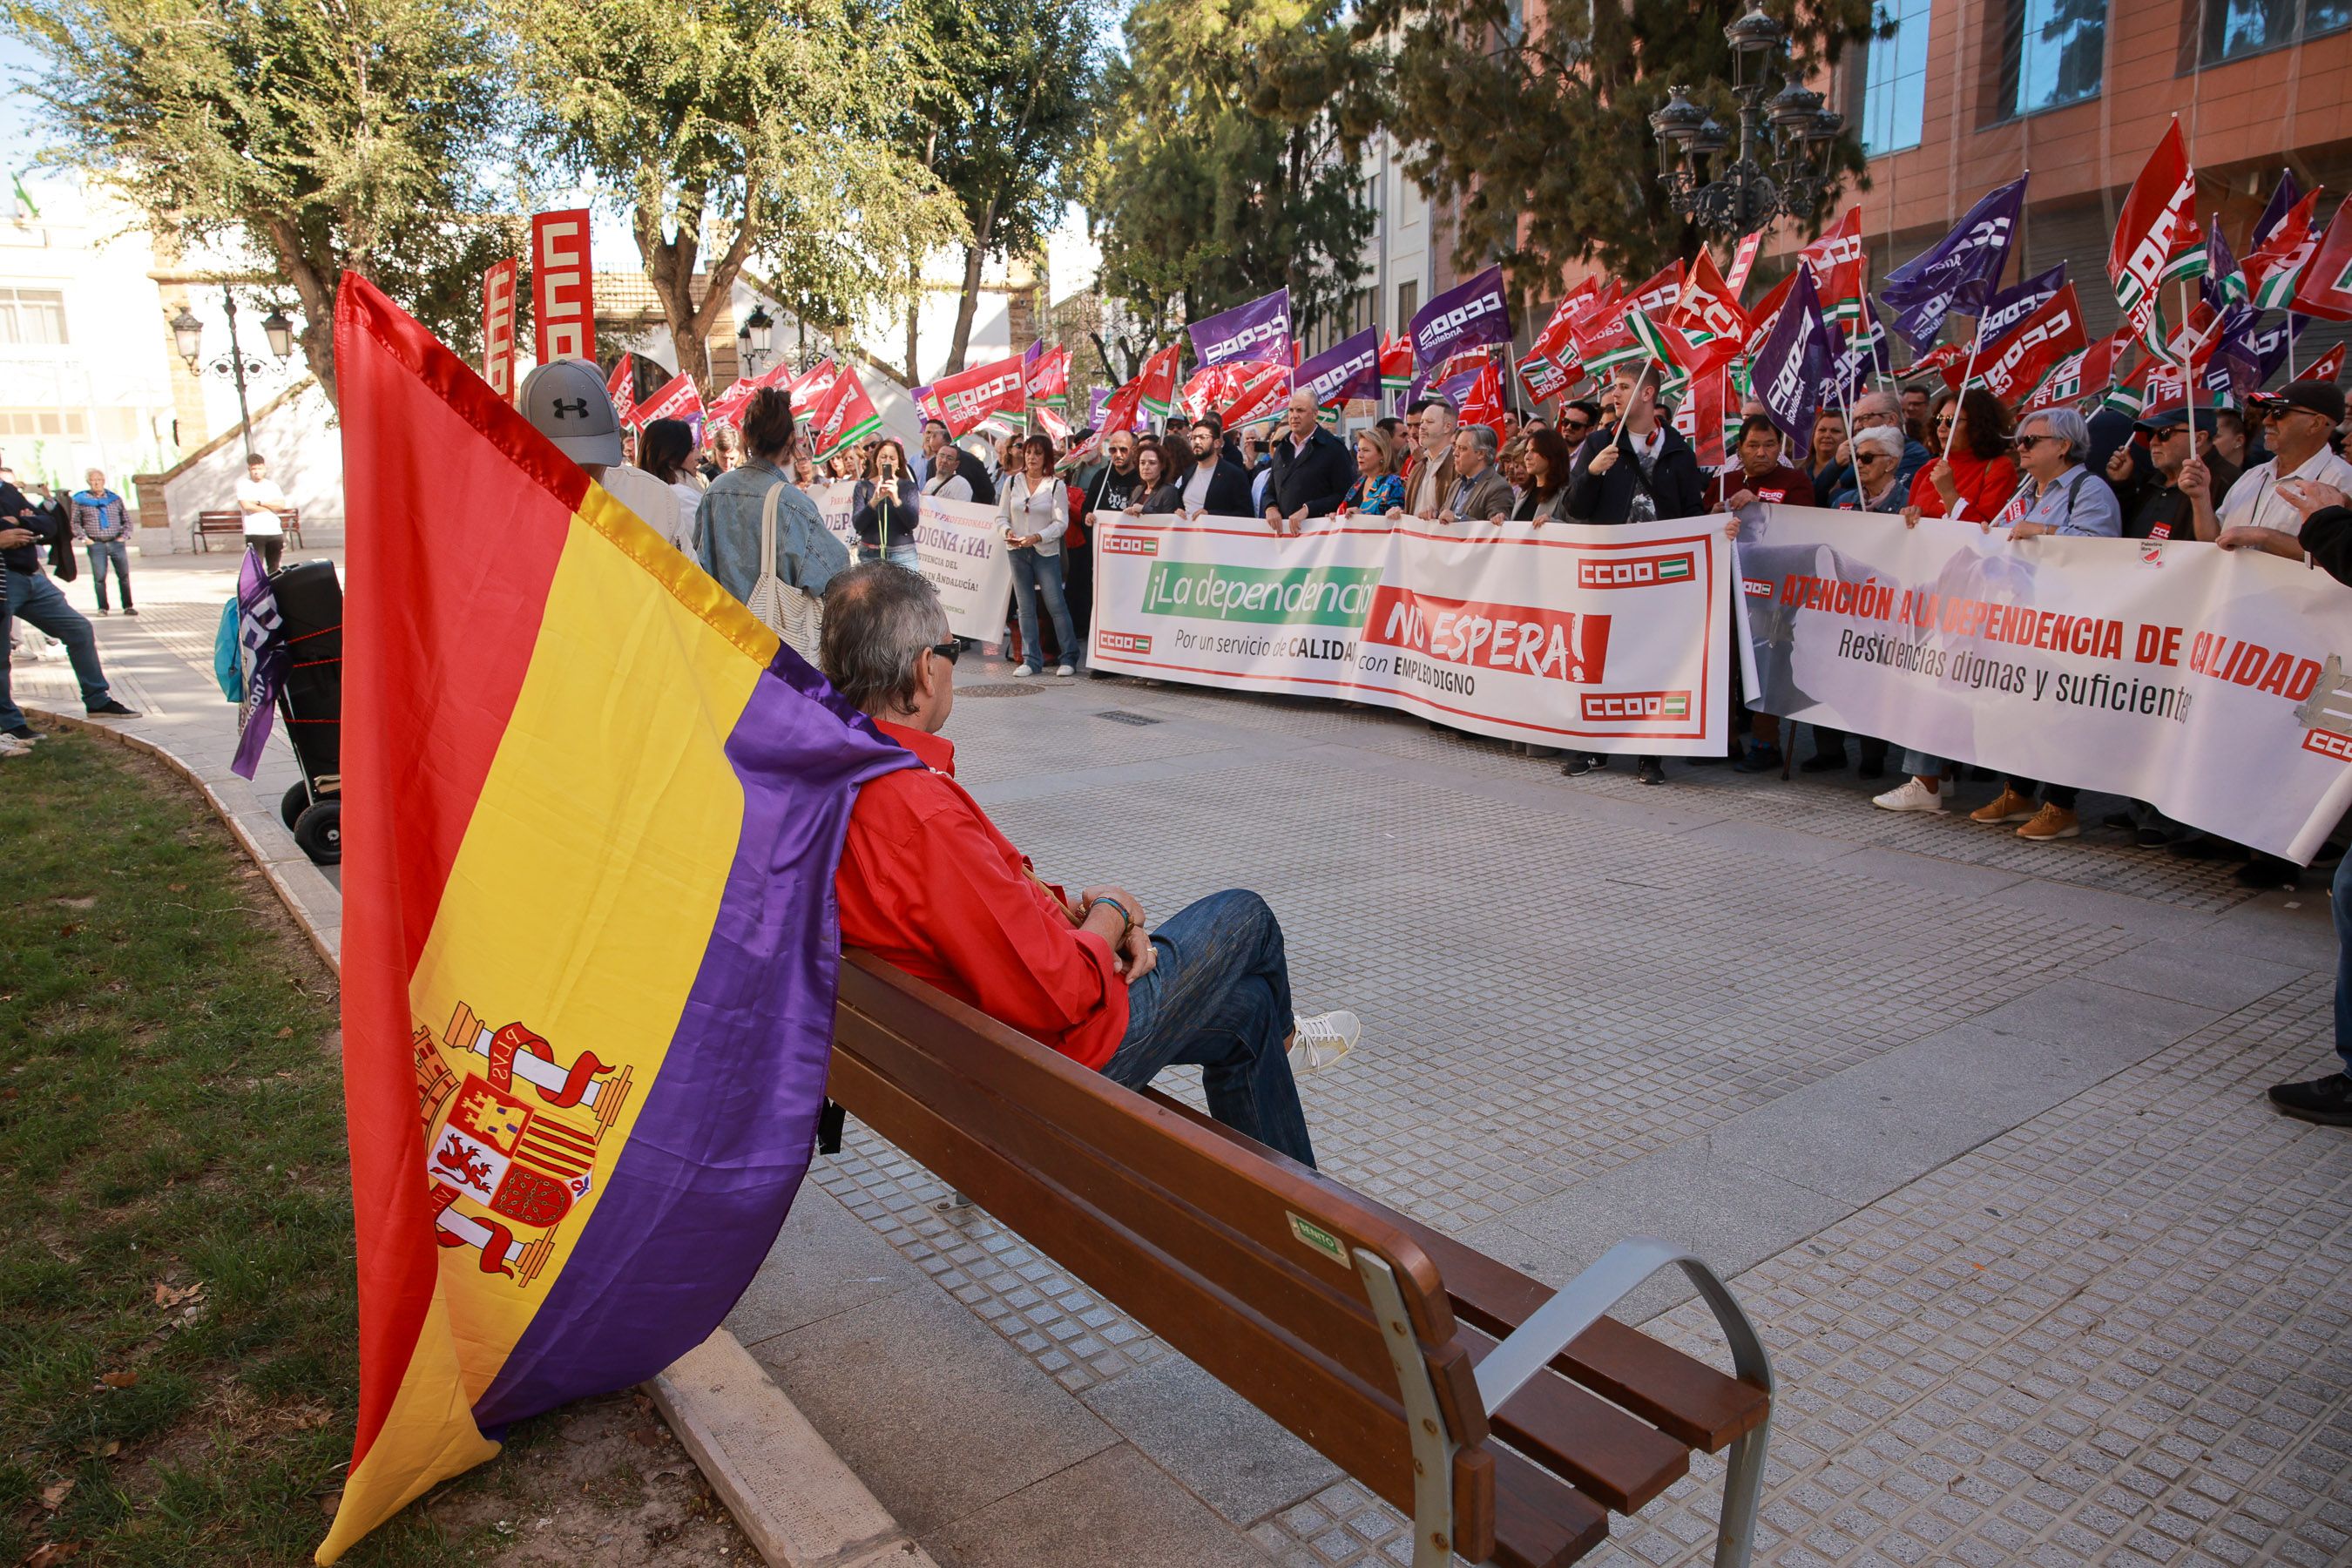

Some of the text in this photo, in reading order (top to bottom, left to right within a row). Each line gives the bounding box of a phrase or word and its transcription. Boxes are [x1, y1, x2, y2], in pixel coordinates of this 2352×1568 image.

[826, 513, 993, 559] DEP DIGNA ¡YA!
[1104, 537, 1141, 552] CCOO
[945, 560, 958, 570] DEL
[1581, 562, 1653, 584] CCOO
[1149, 568, 1374, 619] ¡La dependencia
[1100, 632, 1133, 651] CCOO
[1384, 601, 1585, 682] NO ESPERA!
[1780, 574, 2322, 703] ATENCIÓN A LA DEPENDENCIA DE CALIDAD
[1175, 629, 1198, 649] Por
[1200, 636, 1213, 651] un
[1216, 636, 1270, 657] servicio
[1273, 638, 1287, 658] de
[1288, 637, 1356, 662] CALIDA
[1358, 655, 1389, 673] con
[1394, 657, 1432, 686] EMPLEO
[1433, 669, 1475, 696] DIGNO
[1838, 629, 2193, 725] Residencias dignas y suficientes
[1585, 696, 1662, 716] CCOO
